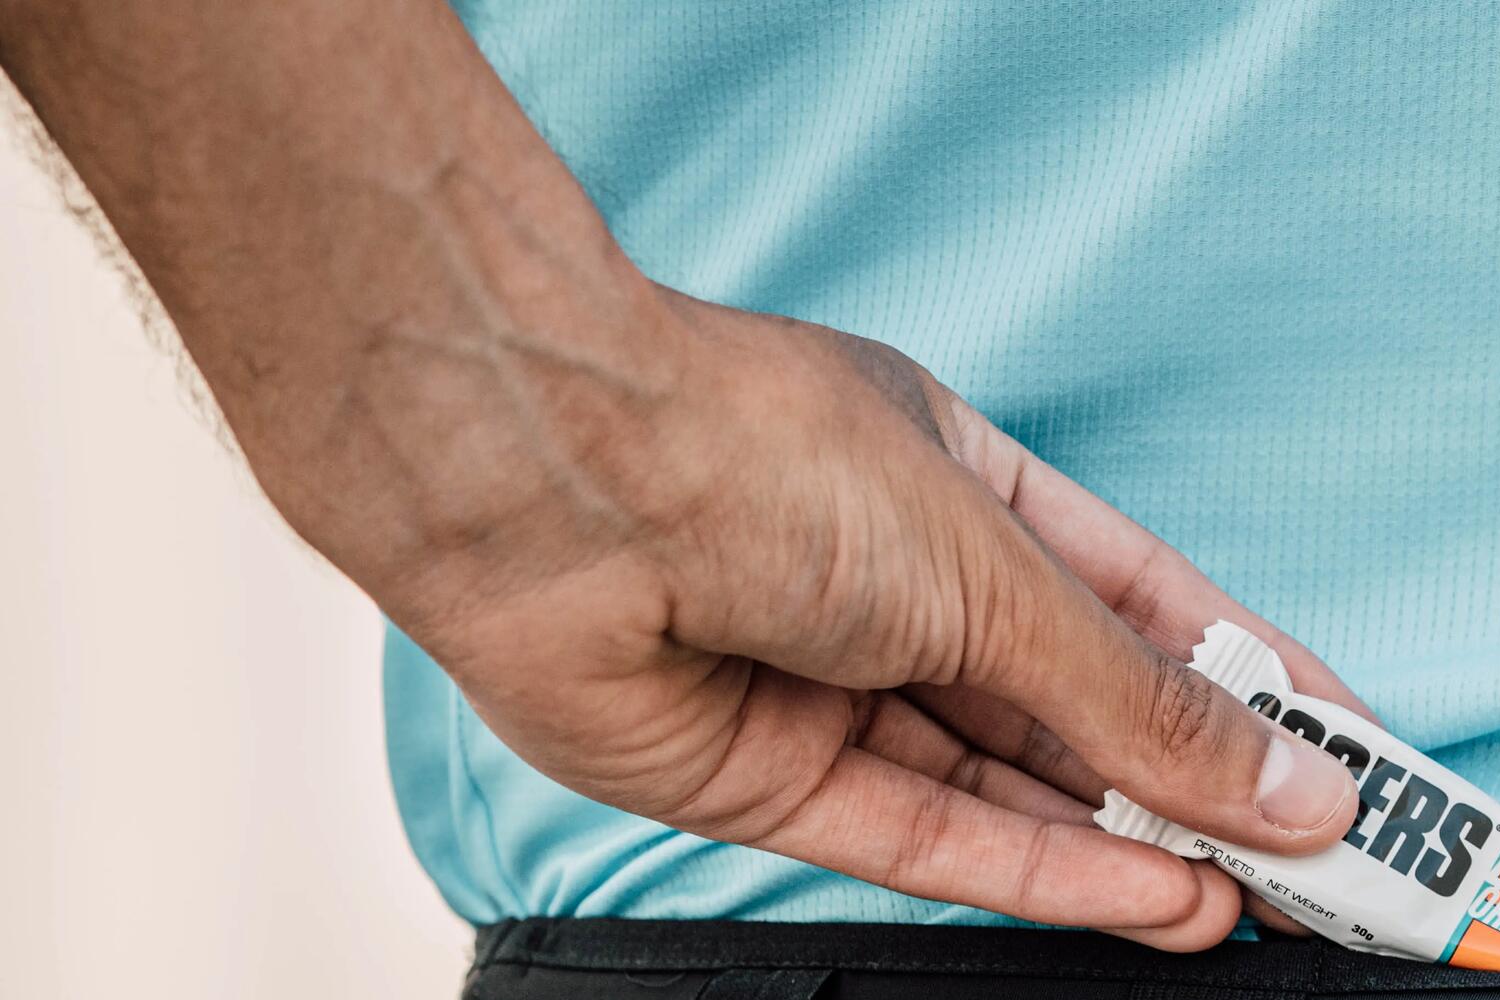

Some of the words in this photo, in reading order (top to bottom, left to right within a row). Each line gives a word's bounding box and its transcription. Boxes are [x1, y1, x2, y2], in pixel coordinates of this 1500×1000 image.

[1248, 692, 1493, 897] ERS
[1193, 839, 1223, 859] PESO
[1224, 854, 1255, 877] NETO
[1266, 879, 1291, 895] NET
[1292, 892, 1337, 920] WEIGHT
[1351, 924, 1374, 941] 30g
